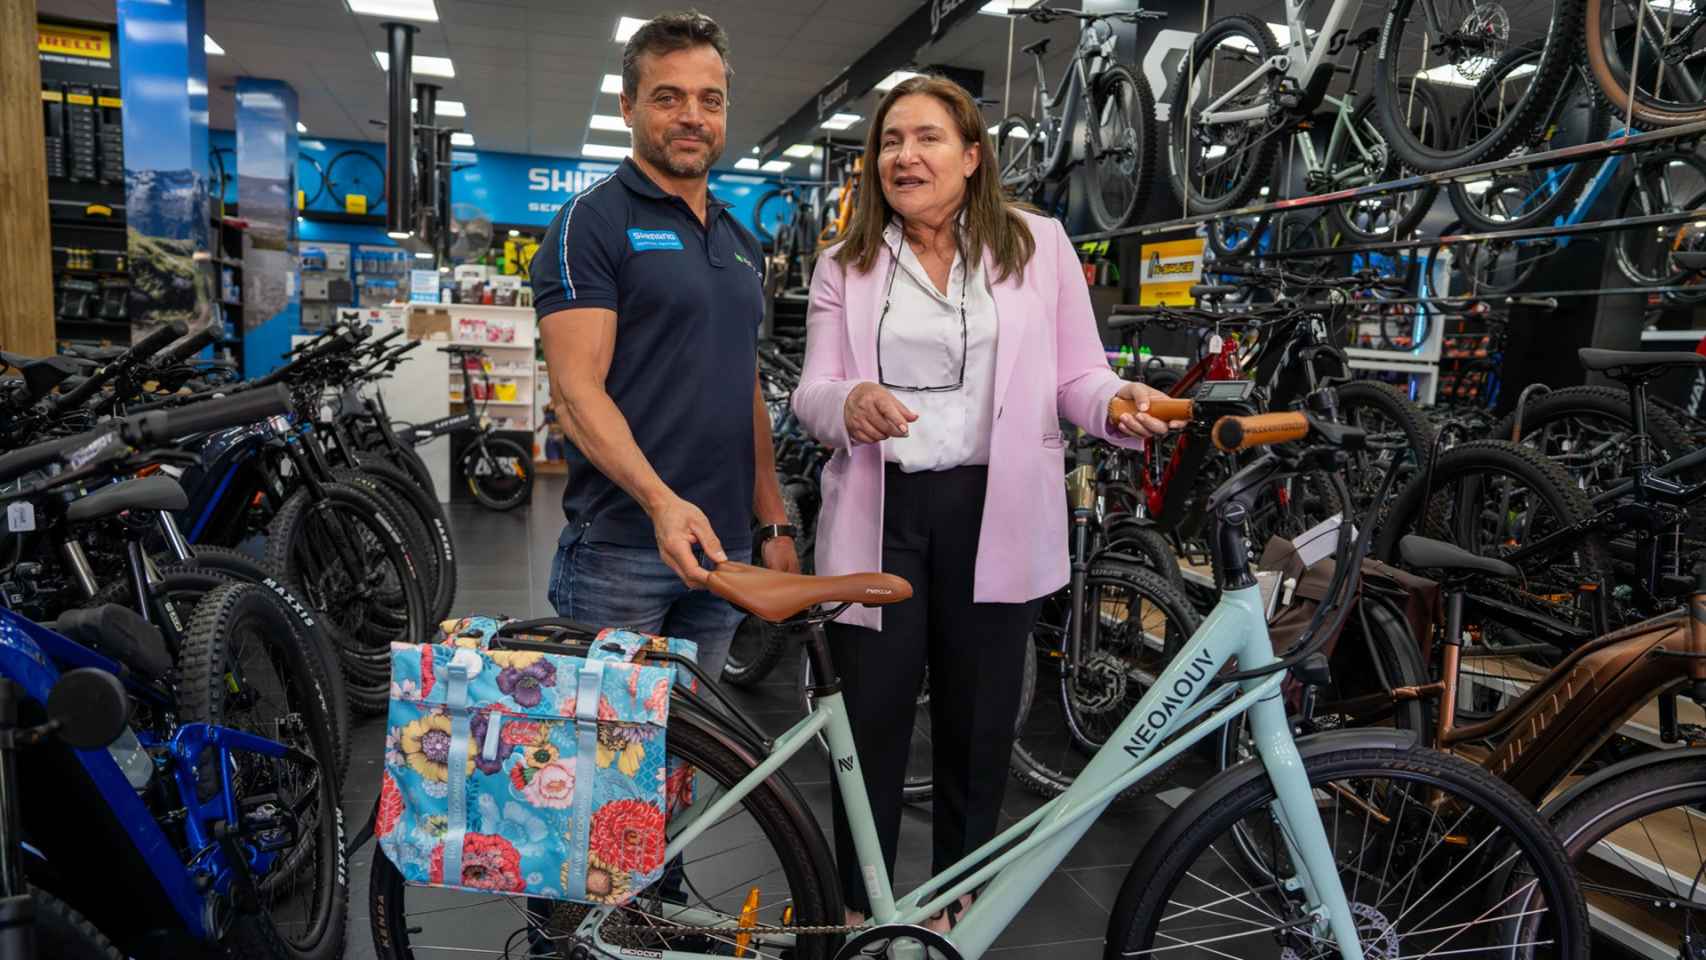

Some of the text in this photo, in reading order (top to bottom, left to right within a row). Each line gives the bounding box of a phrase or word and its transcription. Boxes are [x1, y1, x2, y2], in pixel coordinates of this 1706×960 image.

[262, 577, 315, 626] MAXXIS
[335, 807, 346, 886] MAXXIS
[376, 895, 391, 948] KENDA
